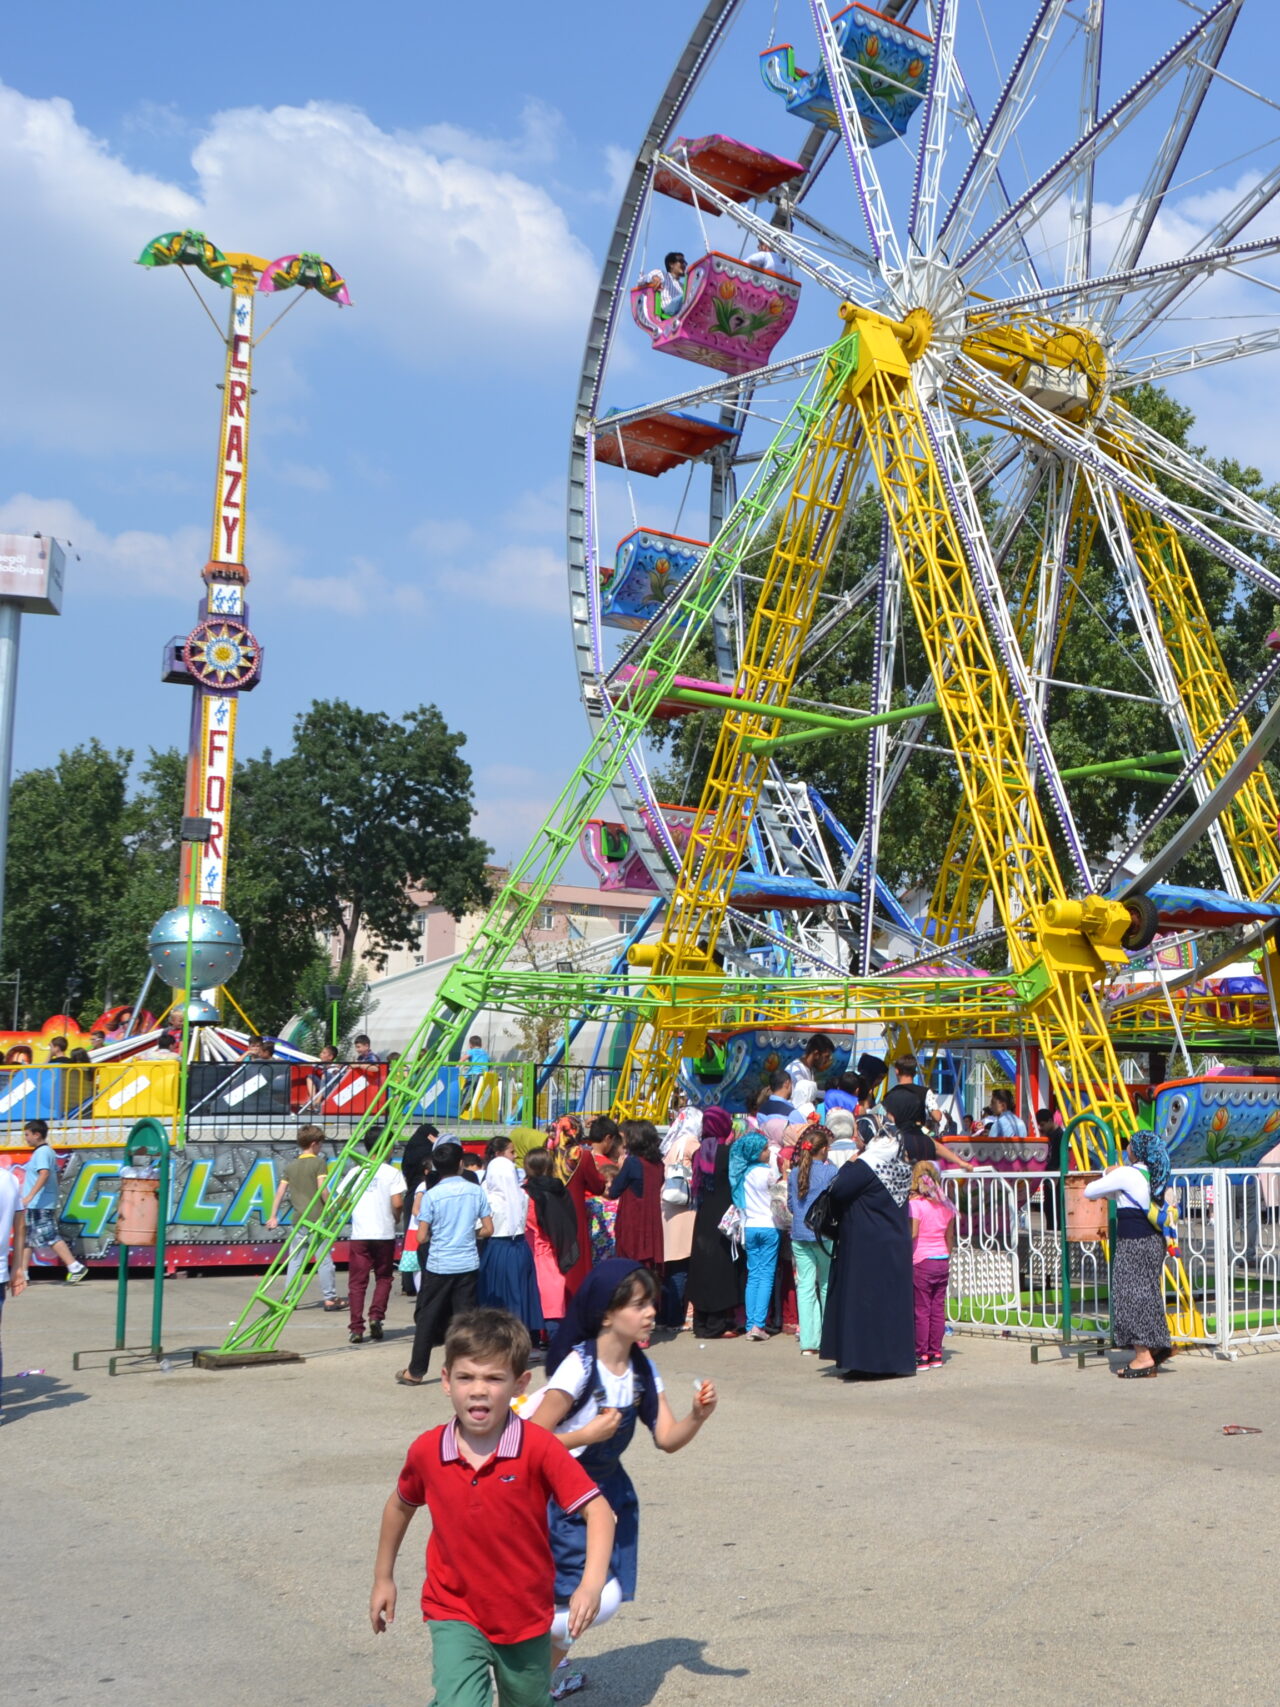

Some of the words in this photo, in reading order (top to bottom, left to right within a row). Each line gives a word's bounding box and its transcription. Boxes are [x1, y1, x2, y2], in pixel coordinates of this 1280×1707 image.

[222, 334, 249, 554] CRAZY
[203, 730, 228, 859] FOR
[61, 1158, 402, 1238] GLA
